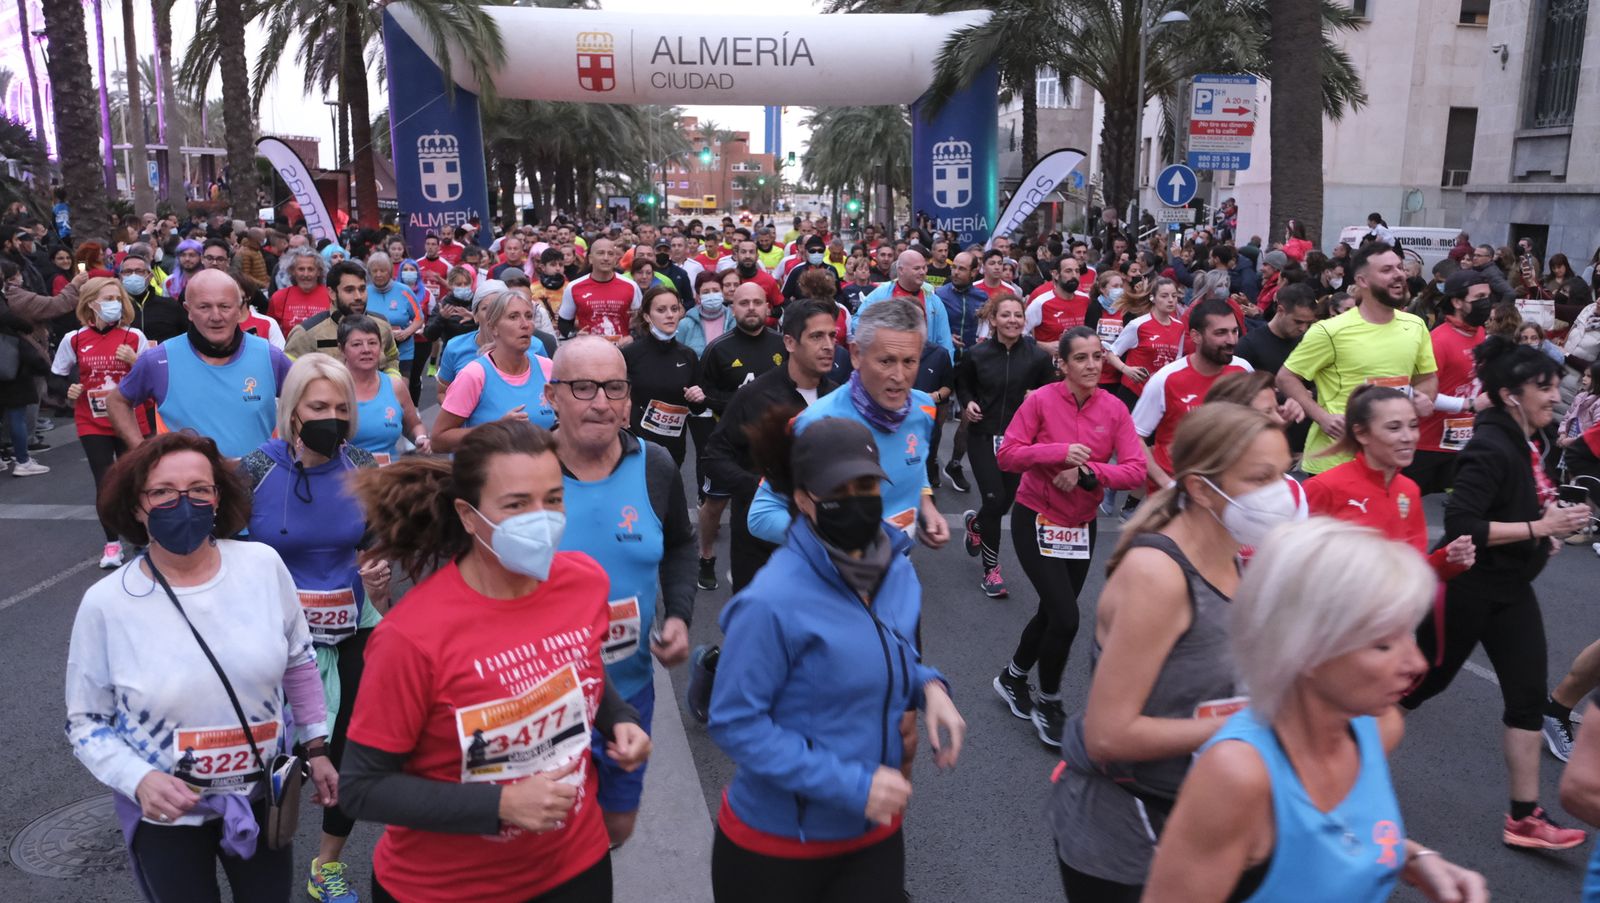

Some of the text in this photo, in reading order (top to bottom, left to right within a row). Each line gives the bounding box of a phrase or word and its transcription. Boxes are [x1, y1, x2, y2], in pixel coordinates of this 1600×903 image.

[650, 31, 815, 66] ALMERÍA
[651, 71, 734, 90] CIUDAD
[1196, 90, 1212, 108] P
[936, 213, 989, 232] MERÍA
[653, 412, 680, 425] 3554
[1452, 429, 1472, 439] 352
[1046, 529, 1079, 542] 3401
[307, 609, 348, 625] 228
[489, 703, 568, 755] 3477
